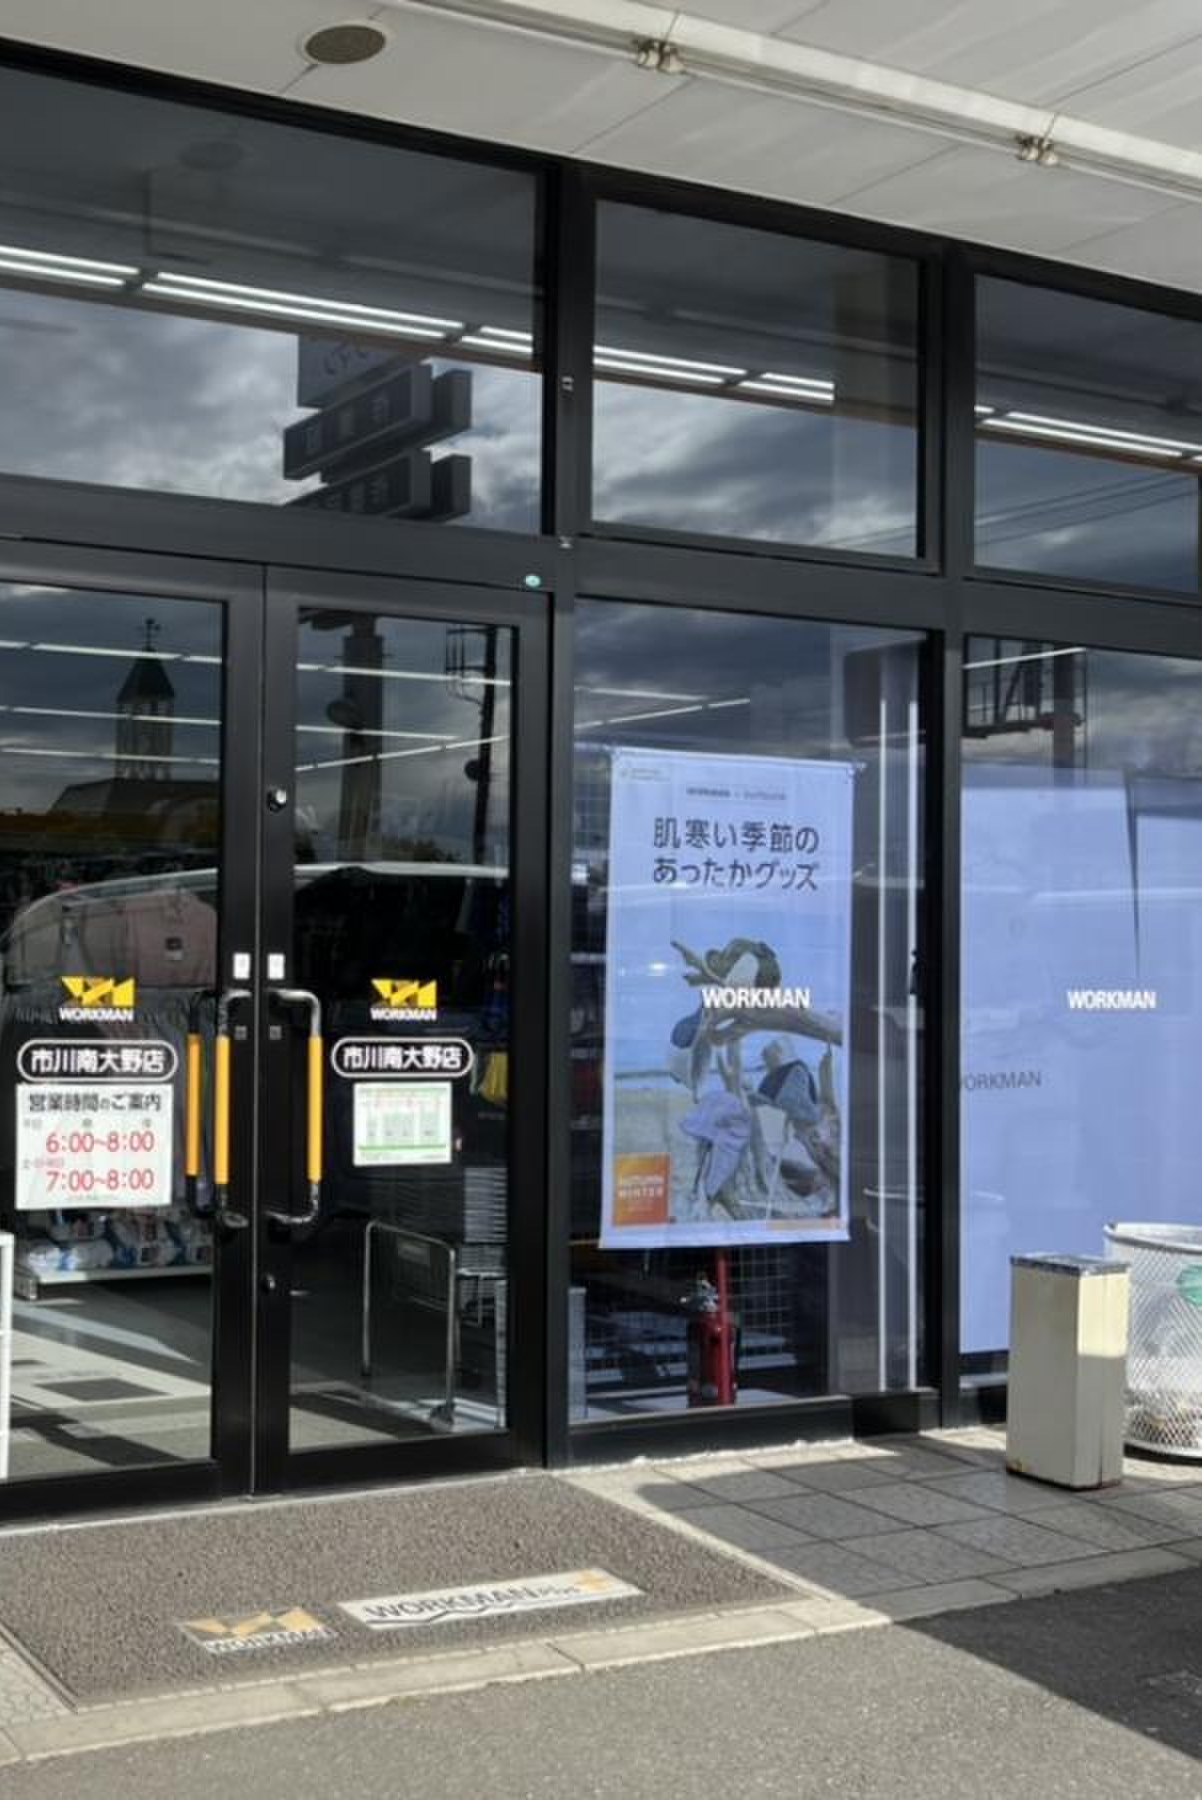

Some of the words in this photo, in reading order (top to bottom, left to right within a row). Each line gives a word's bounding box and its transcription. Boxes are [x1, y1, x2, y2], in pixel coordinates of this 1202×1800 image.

[653, 816, 820, 856] 肌寒い季節の
[653, 858, 820, 892] あったかグッズ
[701, 987, 811, 1009] WORKMAN
[1067, 990, 1157, 1010] WORKMAN
[59, 1007, 133, 1021] WORKMAN
[370, 1008, 437, 1021] WORKMAN
[30, 1048, 165, 1073] 市川南大野店
[343, 1045, 462, 1069] 市川南大野店
[960, 1070, 1042, 1091] ORKMAN
[46, 1130, 155, 1153] 6:00~8:00
[46, 1168, 155, 1192] 7:00~8:00
[364, 1587, 539, 1618] WORKMAN
